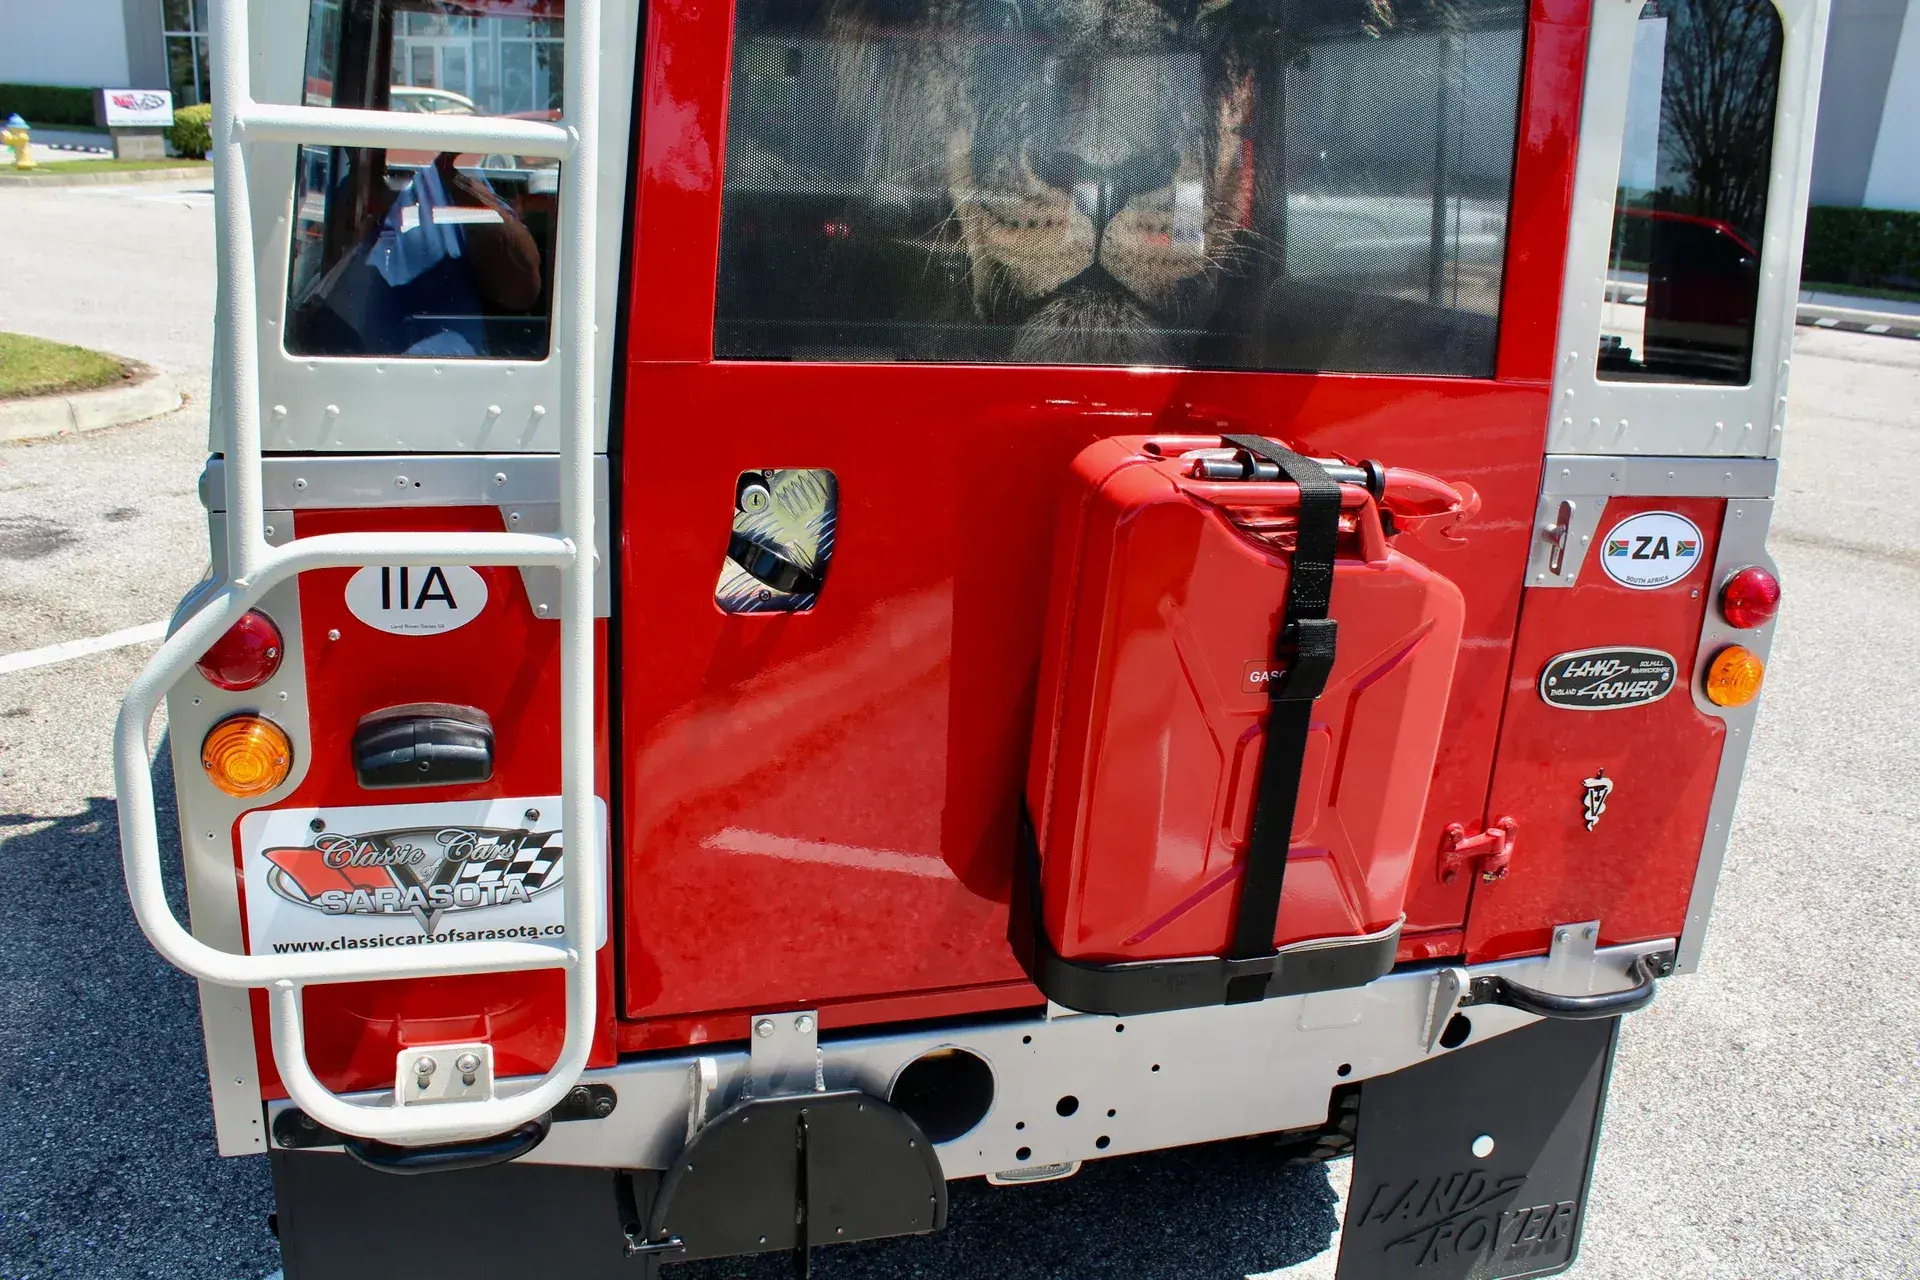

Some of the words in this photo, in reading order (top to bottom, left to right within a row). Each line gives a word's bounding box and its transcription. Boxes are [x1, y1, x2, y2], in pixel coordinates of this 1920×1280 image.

[1631, 536, 1670, 560] ZA
[382, 566, 458, 610] IIA
[1626, 575, 1646, 584] SOUTH
[1646, 575, 1670, 584] AFRICA
[1562, 659, 1621, 678] LAND
[1550, 688, 1577, 696] ENGLAND
[1591, 680, 1659, 700] ROVER
[313, 832, 426, 869] Classic
[434, 828, 516, 863] Cars
[320, 878, 532, 916] SARASOTA
[273, 924, 566, 954] www.classiccarsofsarasota.co
[1357, 1168, 1489, 1228] LAND
[1414, 1200, 1578, 1267] ROVER
